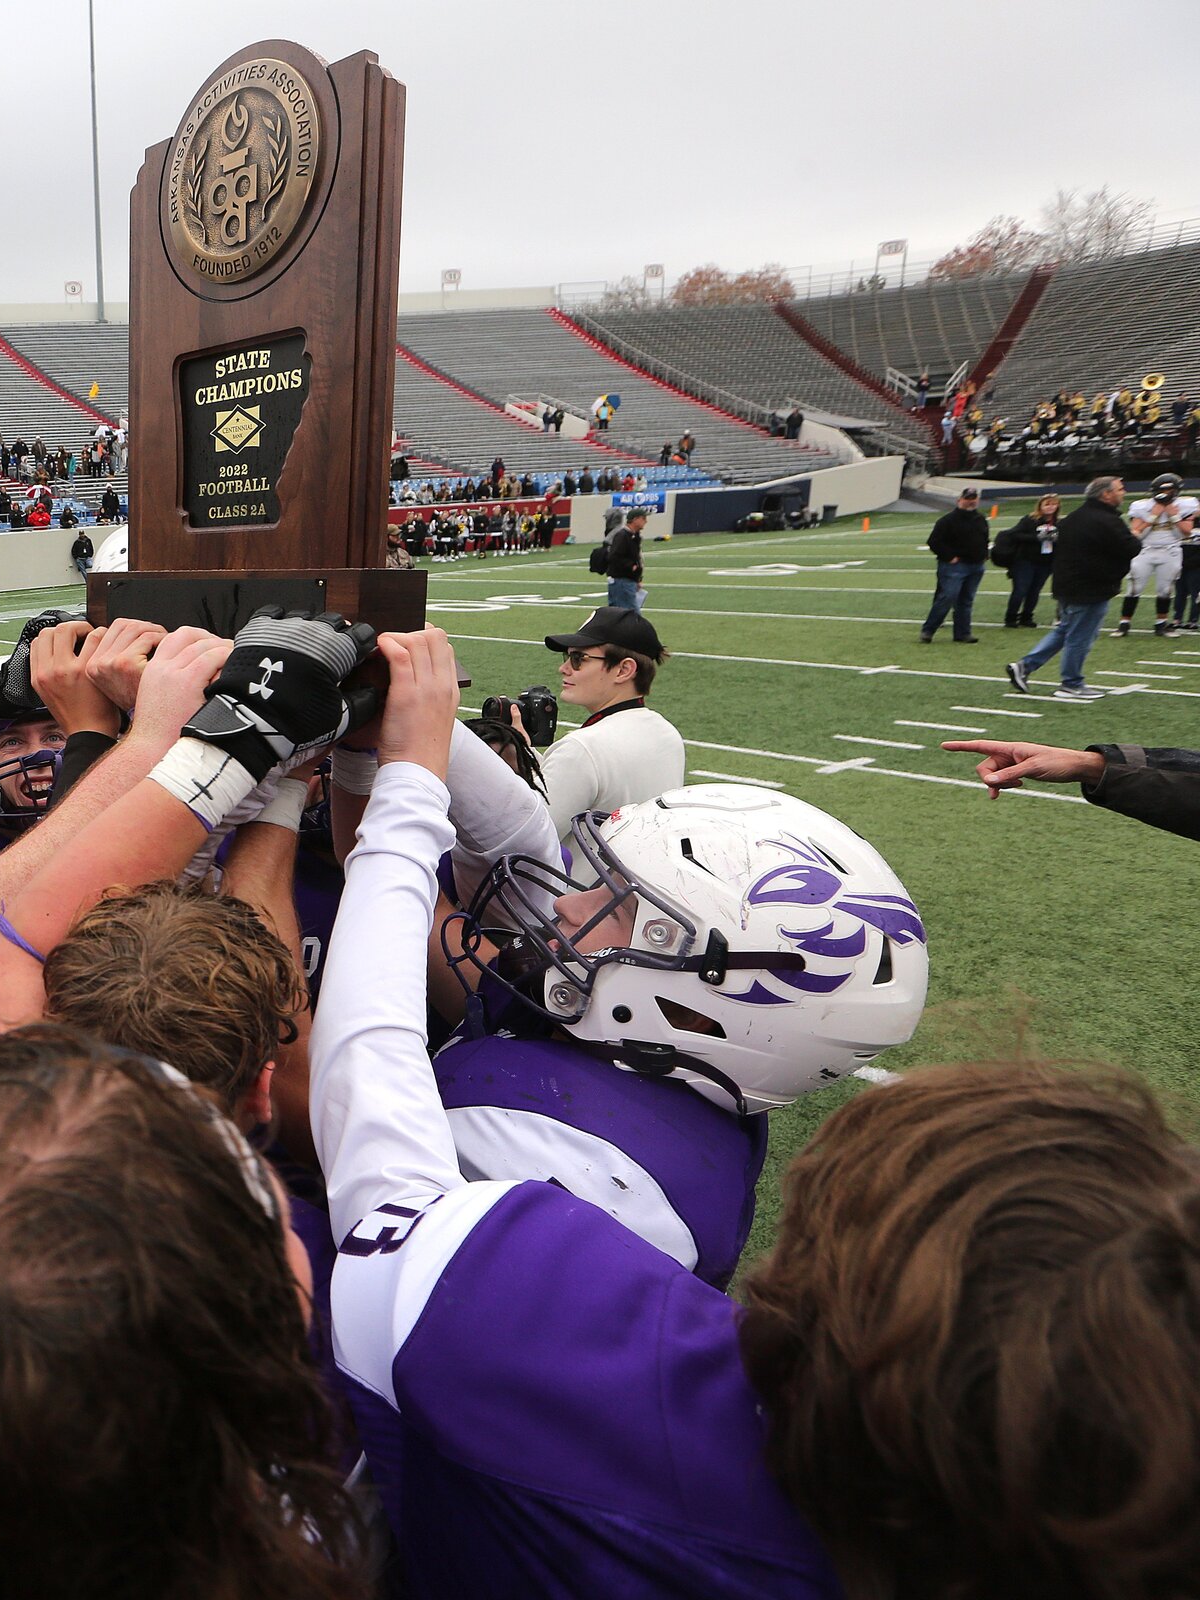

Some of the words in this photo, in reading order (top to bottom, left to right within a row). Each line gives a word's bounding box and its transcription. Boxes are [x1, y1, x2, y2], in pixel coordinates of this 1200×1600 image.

[171, 123, 195, 224] ARKANSAS
[197, 64, 268, 119] ACTIVITIES
[267, 67, 312, 177] ASSOCIATION
[192, 253, 251, 277] FOUNDED
[253, 226, 283, 259] 1912
[215, 350, 271, 379] STATE
[195, 368, 302, 406] CHAMPIONS
[219, 463, 249, 478] 2022
[198, 477, 270, 497] FOOTBALL
[208, 505, 248, 519] CLASS
[250, 503, 267, 516] 2A
